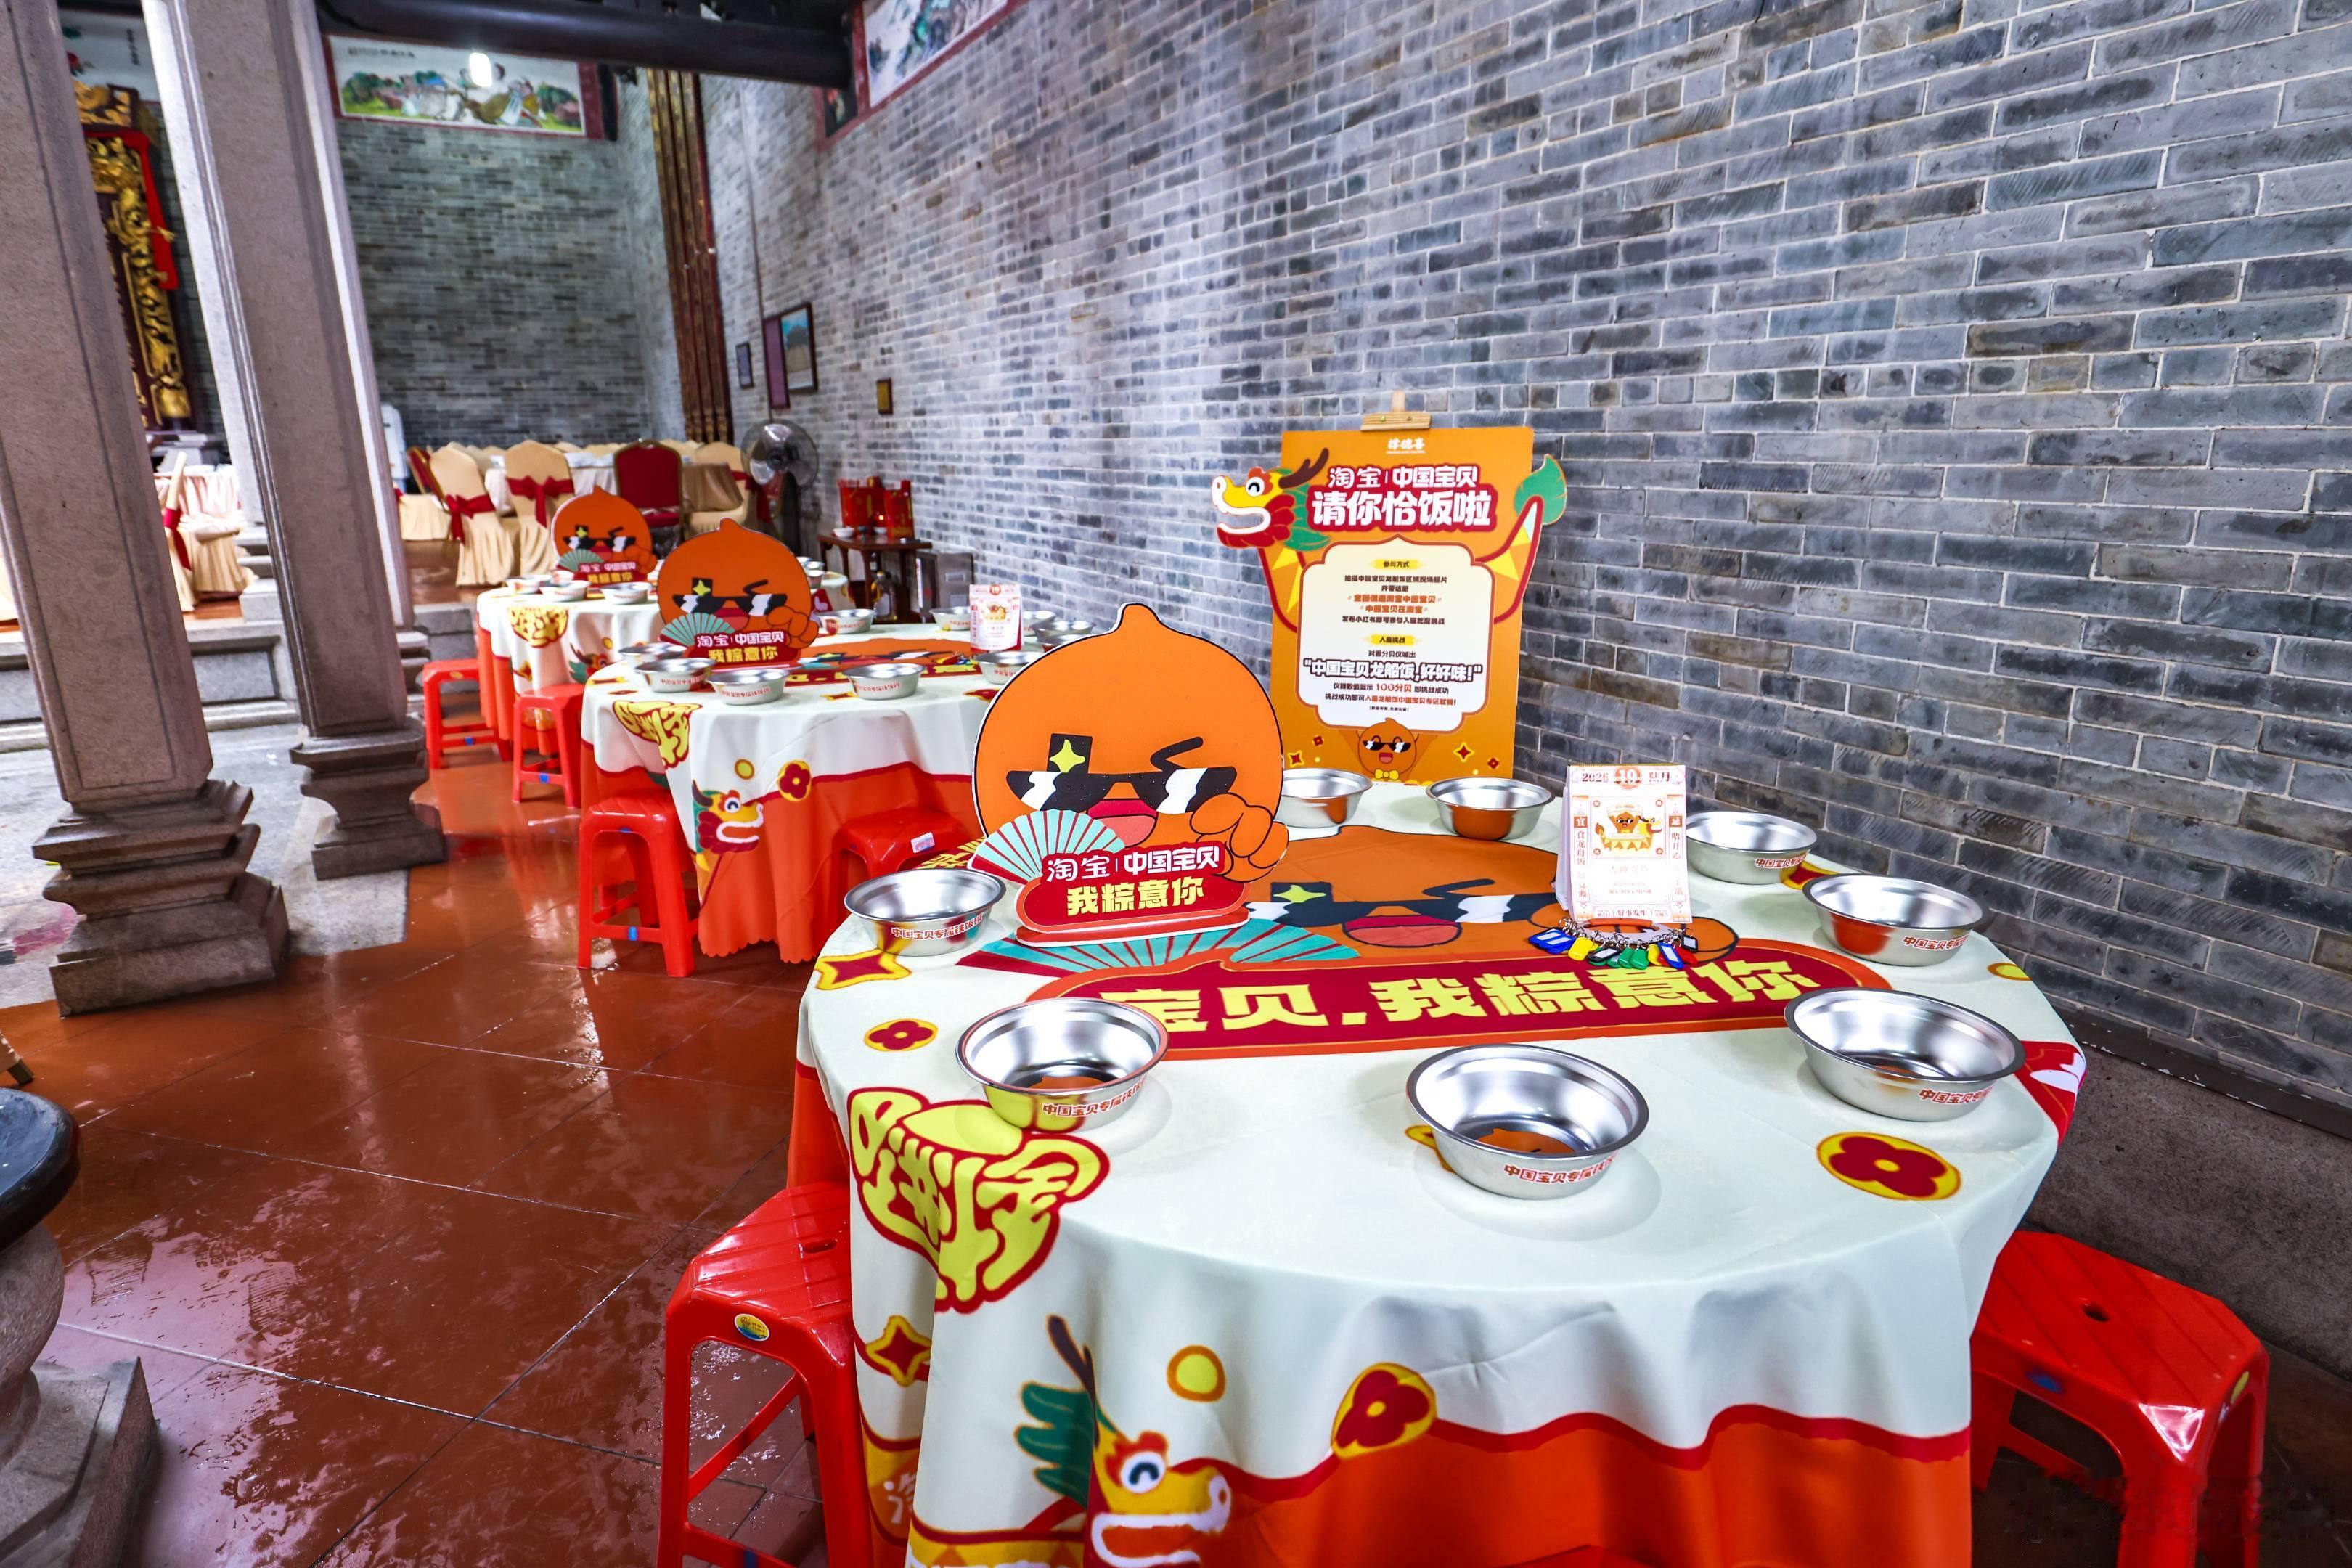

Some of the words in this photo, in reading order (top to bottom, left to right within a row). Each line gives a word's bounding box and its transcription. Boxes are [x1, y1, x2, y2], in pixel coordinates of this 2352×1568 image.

[1328, 467, 1381, 489] 淘宝
[1392, 466, 1478, 488] 中国宝贝
[1312, 490, 1492, 526] 请你恰饭啦
[697, 635, 728, 648] 淘宝
[735, 632, 784, 645] 中国宝贝
[1047, 857, 1110, 882] 淘宝
[1123, 845, 1220, 875] 中国宝贝
[1066, 875, 1204, 916] 我粽意你
